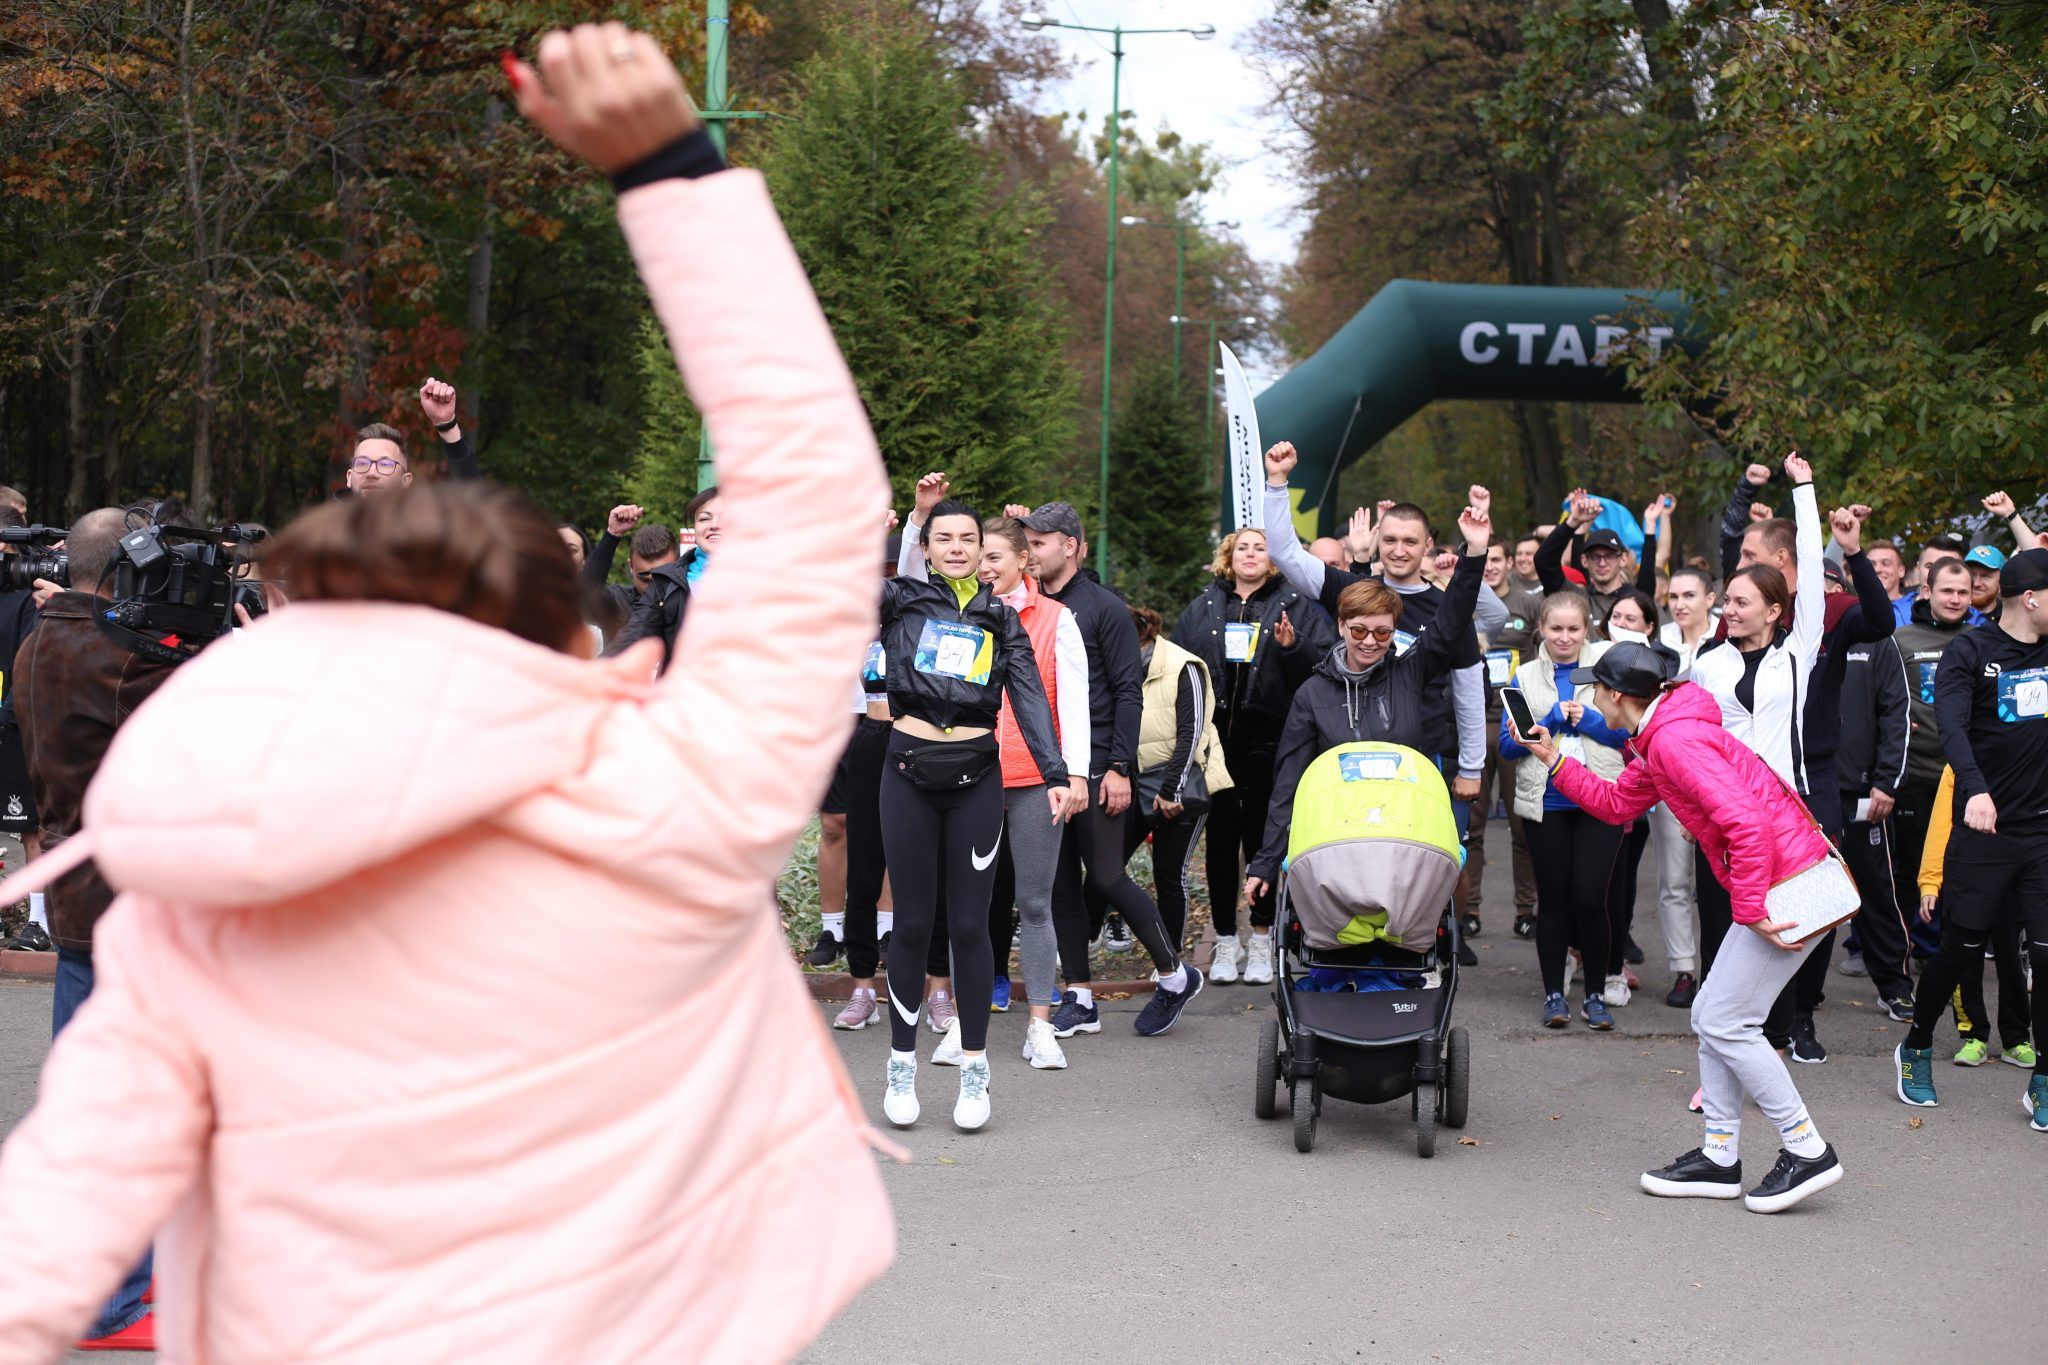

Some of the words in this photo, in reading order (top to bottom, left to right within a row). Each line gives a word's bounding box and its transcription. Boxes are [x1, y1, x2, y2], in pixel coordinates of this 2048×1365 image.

[940, 643, 966, 667] 34
[1392, 1003, 1417, 1013] Tutis
[1788, 1129, 1815, 1145] HOME
